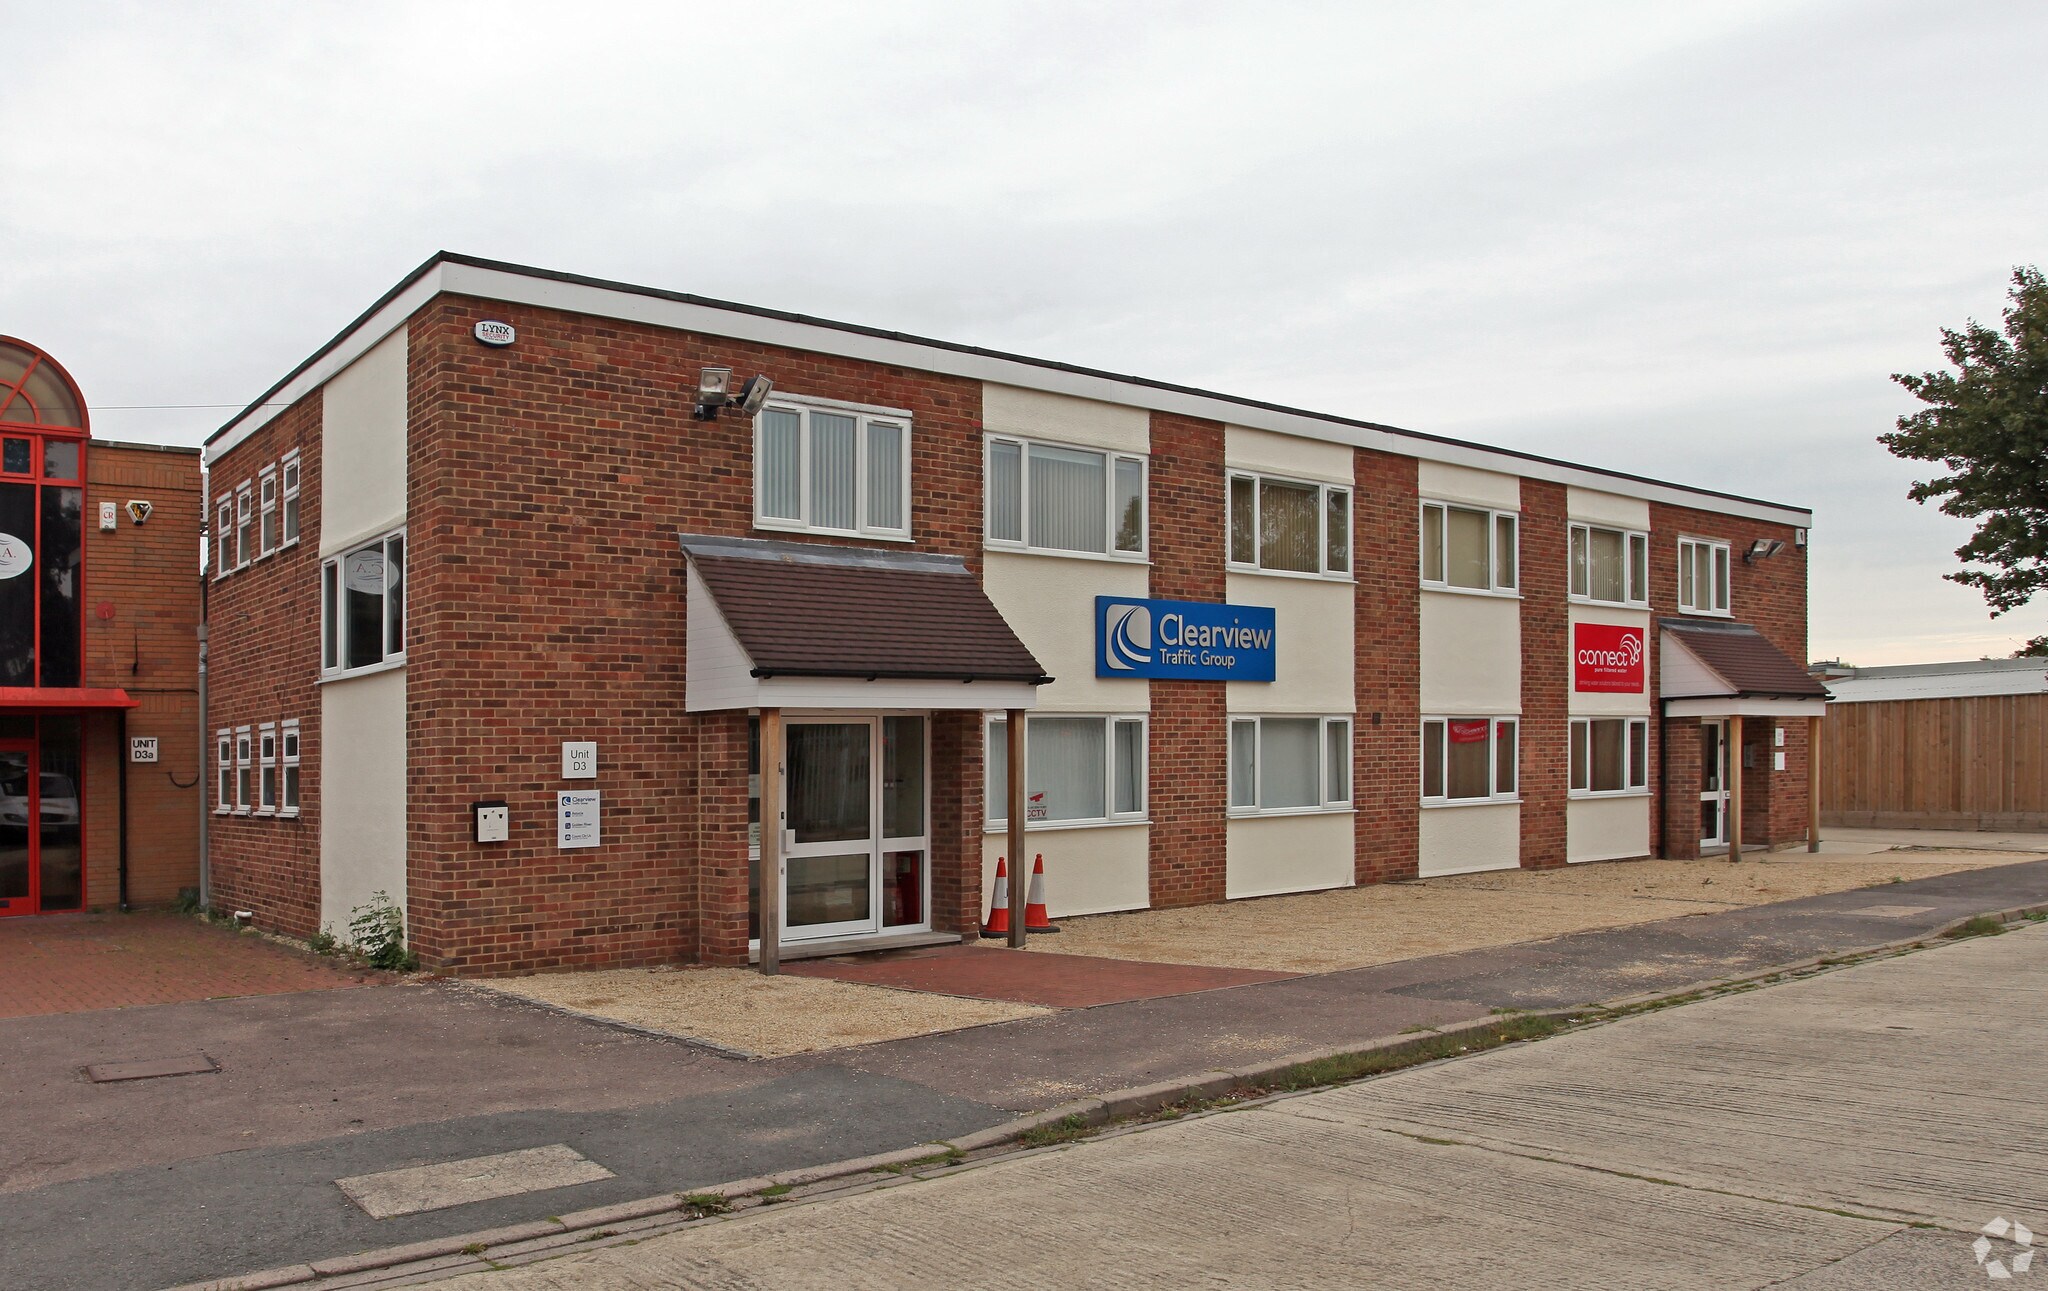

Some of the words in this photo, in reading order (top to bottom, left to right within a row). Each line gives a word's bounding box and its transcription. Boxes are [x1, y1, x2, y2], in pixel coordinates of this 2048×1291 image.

[481, 323, 510, 335] LYNX
[481, 332, 509, 340] SECURITY
[103, 511, 114, 519] CR
[1159, 613, 1272, 650] Clearview
[1159, 648, 1197, 665] Traffic
[1200, 650, 1236, 669] Group
[1578, 649, 1628, 666] connect
[132, 739, 156, 748] UNIT
[134, 750, 154, 759] D3a
[570, 749, 590, 759] Unit
[573, 761, 587, 771] D3
